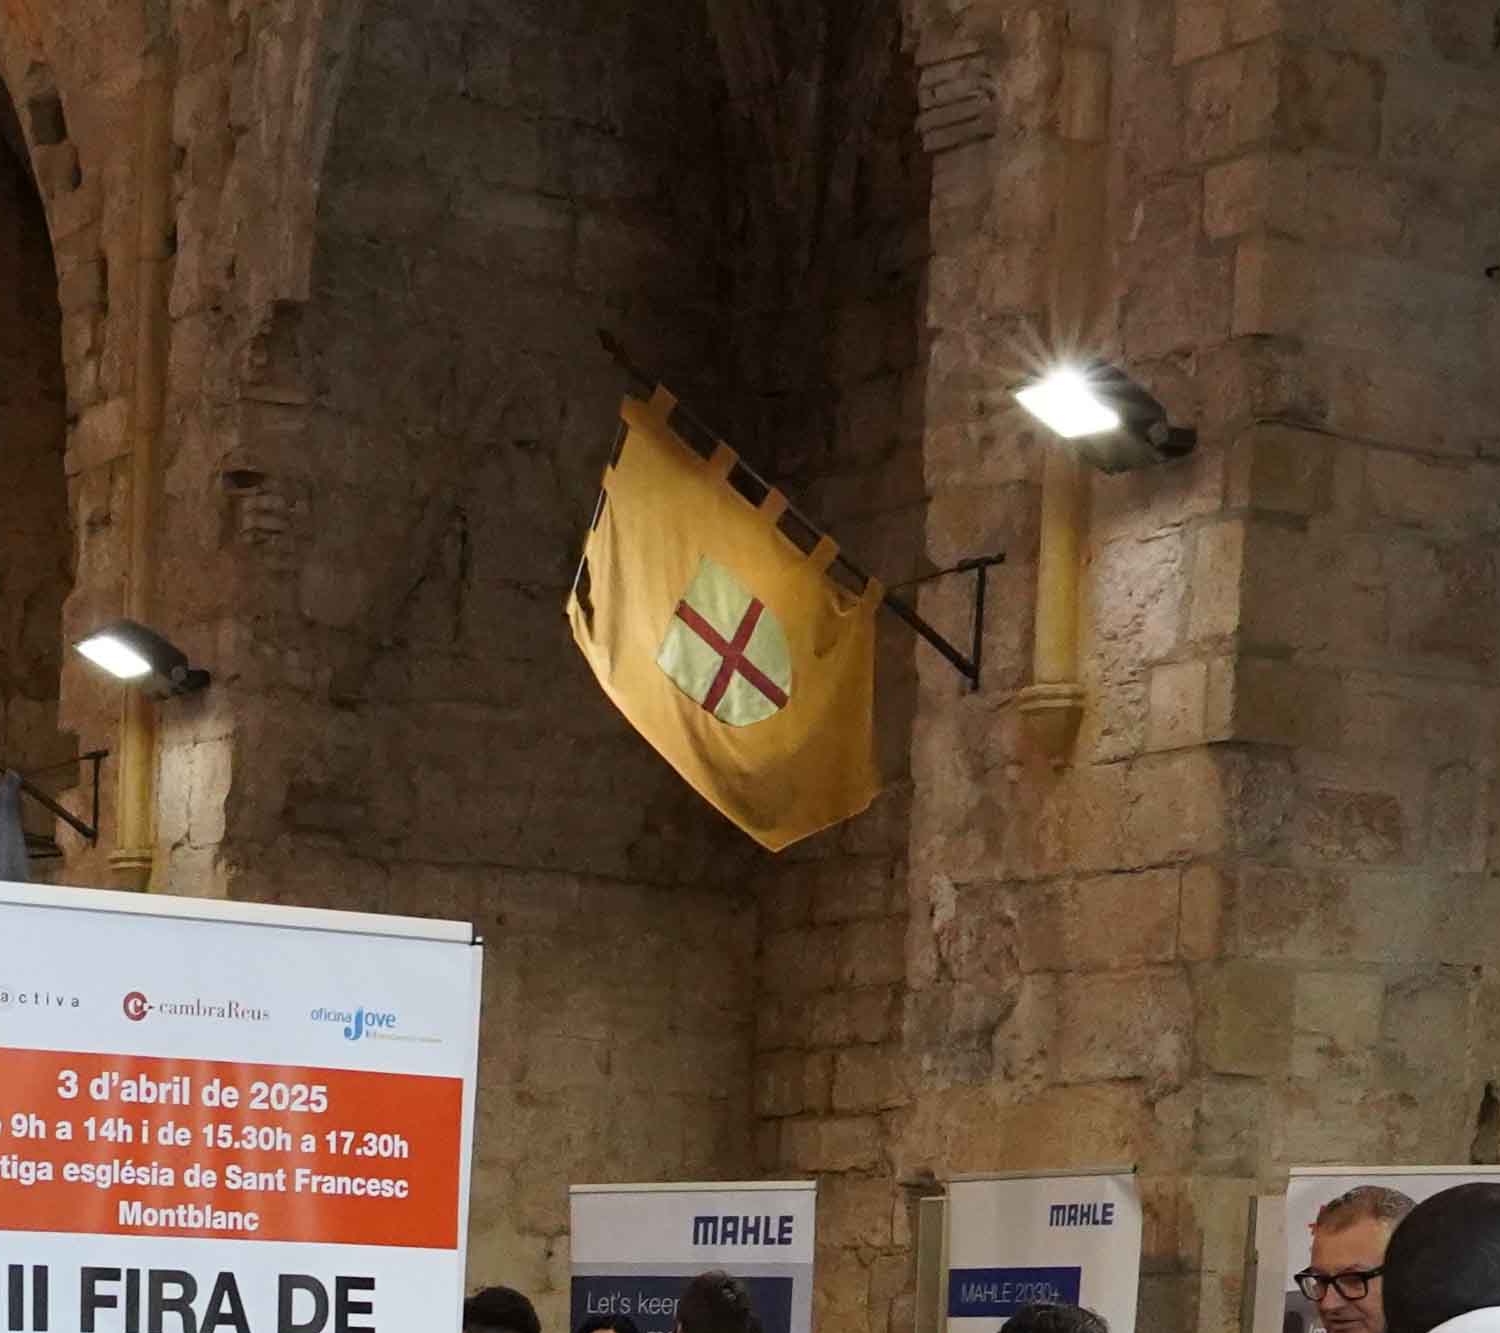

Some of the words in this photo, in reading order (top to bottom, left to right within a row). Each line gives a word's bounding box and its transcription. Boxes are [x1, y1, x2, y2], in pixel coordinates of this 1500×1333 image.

[159, 997, 270, 1022] cambraReus
[58, 1070, 78, 1098] 3
[90, 1072, 190, 1106] d'abril
[201, 1079, 239, 1108] de
[249, 1082, 328, 1113] 2025
[10, 1113, 46, 1139] 9h
[56, 1120, 73, 1140] a
[84, 1117, 133, 1143] 14h
[141, 1119, 149, 1144] i
[157, 1121, 192, 1147] de
[202, 1124, 292, 1152] 15.30h
[301, 1132, 316, 1153] a
[325, 1130, 409, 1159] 17.30h
[63, 1158, 175, 1190] església
[184, 1162, 217, 1189] de
[225, 1165, 287, 1192] Sant
[294, 1168, 409, 1199] Francesc
[118, 1201, 260, 1232] Montblanc
[692, 1215, 794, 1246] MAHLE
[1049, 1203, 1115, 1227] MAHLE
[8, 1264, 48, 1332] II
[587, 1292, 632, 1316] Let's
[961, 1283, 1012, 1304] MAHLE
